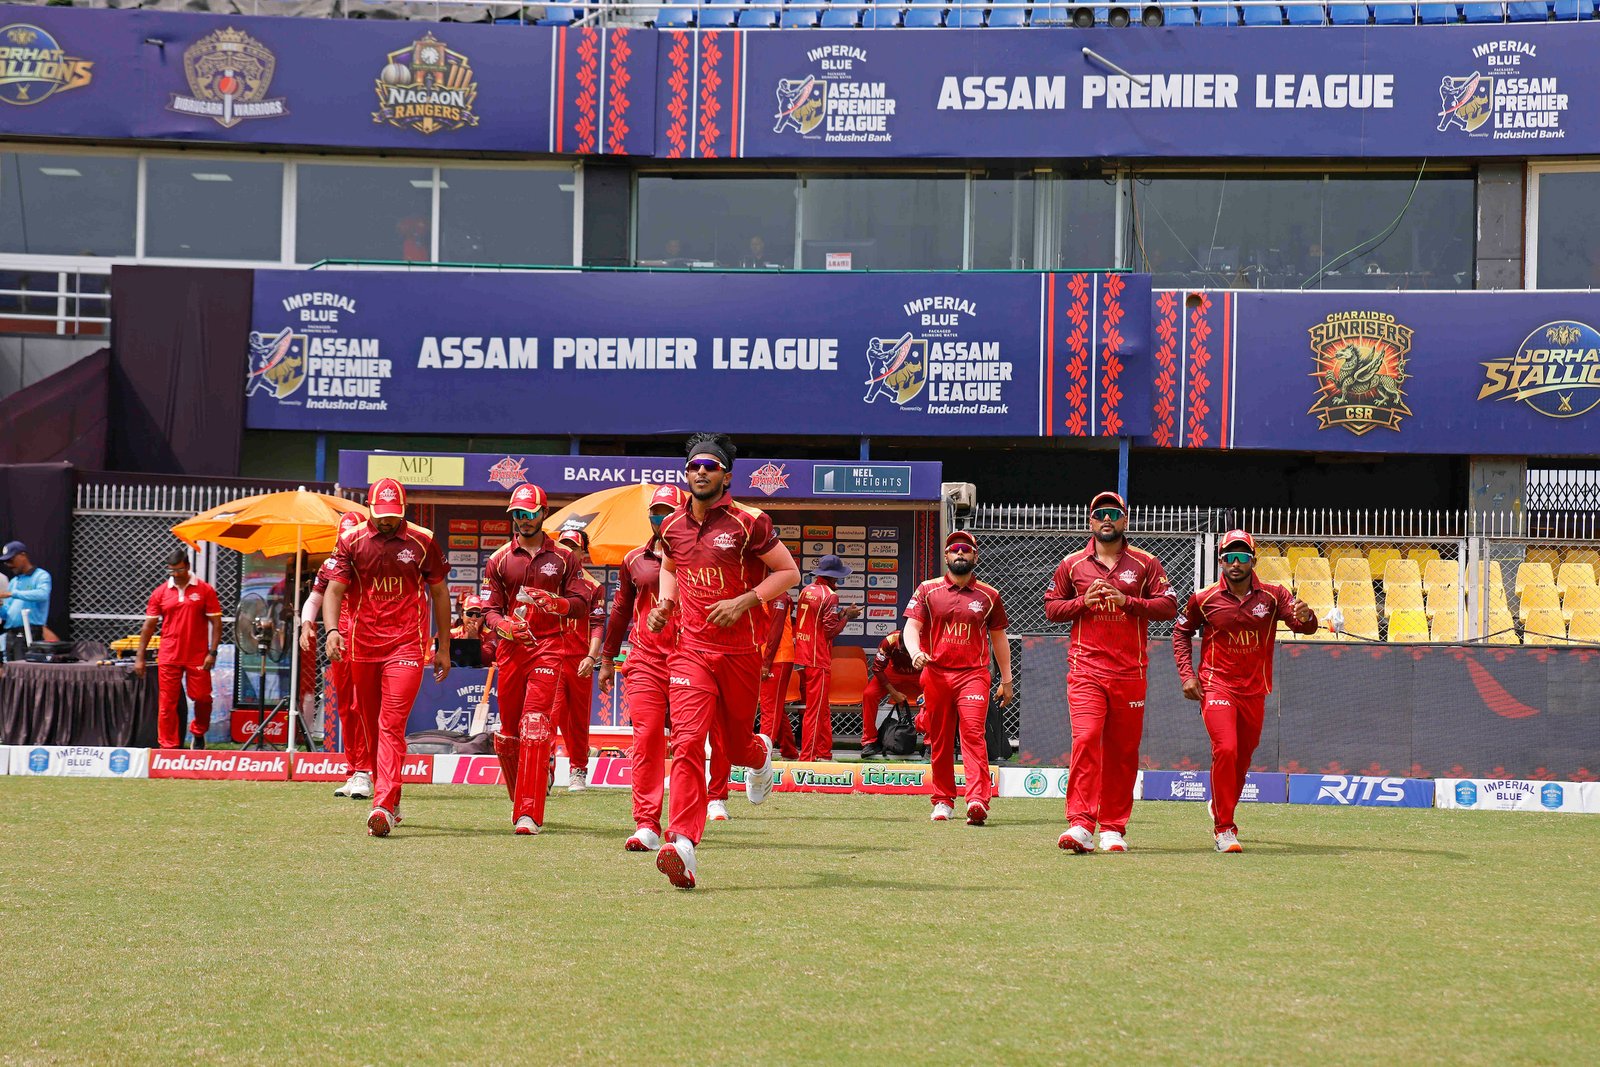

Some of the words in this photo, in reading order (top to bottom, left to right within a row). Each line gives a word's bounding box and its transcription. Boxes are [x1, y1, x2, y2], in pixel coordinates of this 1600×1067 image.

[0, 47, 65, 61] ORHAT
[807, 45, 867, 62] IMPERIAL
[1472, 40, 1536, 58] IMPERIAL
[821, 59, 852, 70] BLUE
[1488, 55, 1520, 65] BLUE
[828, 82, 885, 98] ASSAM
[937, 76, 1066, 110] ASSAM
[1083, 74, 1239, 109] PREMIER
[1256, 74, 1394, 108] LEAGUE
[1495, 78, 1556, 94] ASSAM
[388, 88, 465, 108] NAGAON
[1494, 94, 1568, 111] PREMIER
[394, 104, 460, 120] RANGERS
[827, 99, 896, 115] PREMIER
[826, 116, 886, 131] LEAGUE
[1494, 111, 1558, 128] LEAGUE
[825, 133, 867, 142] IndusInd
[868, 133, 892, 142] Bank
[1493, 130, 1538, 139] IndusInd
[1540, 129, 1565, 138] Bank
[282, 292, 356, 314] IMPERIAL
[904, 296, 977, 316] IMPERIAL
[300, 309, 338, 322] BLUE
[921, 314, 958, 326] BLUE
[1326, 310, 1395, 323] CHARAIDEO
[1310, 319, 1411, 351] SUNRISERS
[309, 338, 379, 358] ASSAM
[417, 336, 538, 369] ASSAM
[553, 337, 697, 370] PREMIER
[713, 338, 838, 370] LEAGUE
[930, 342, 999, 361] ASSAM
[1516, 349, 1600, 366] JORHA
[308, 358, 392, 378] PREMIER
[929, 362, 1012, 381] PREMIER
[308, 378, 381, 398] LEAGUE
[929, 382, 1001, 401] LEAGUE
[306, 398, 356, 410] IndusInd
[358, 400, 388, 410] Bank
[927, 404, 978, 414] IndusInd
[980, 404, 1008, 414] Bank
[1346, 408, 1373, 419] CSR
[400, 457, 433, 476] MPJ
[853, 468, 874, 477] NEEL
[564, 467, 625, 481] BARAK
[631, 469, 688, 483] LEGEN
[752, 476, 788, 486] BARAK
[855, 477, 902, 487] HEIGHTS
[687, 566, 724, 589] MPJ
[371, 577, 403, 595] MPJ
[944, 622, 972, 640] MPJ
[1228, 630, 1260, 647] MPJ
[534, 667, 554, 675] TYKA
[56, 748, 104, 760] IMPERIAL
[152, 754, 236, 772] IndusInd
[237, 756, 285, 773] Bank
[296, 758, 348, 775] Indus
[792, 770, 852, 786] Vimal
[1484, 781, 1535, 794] IMPERIAL
[1497, 793, 1522, 801] BLUE
